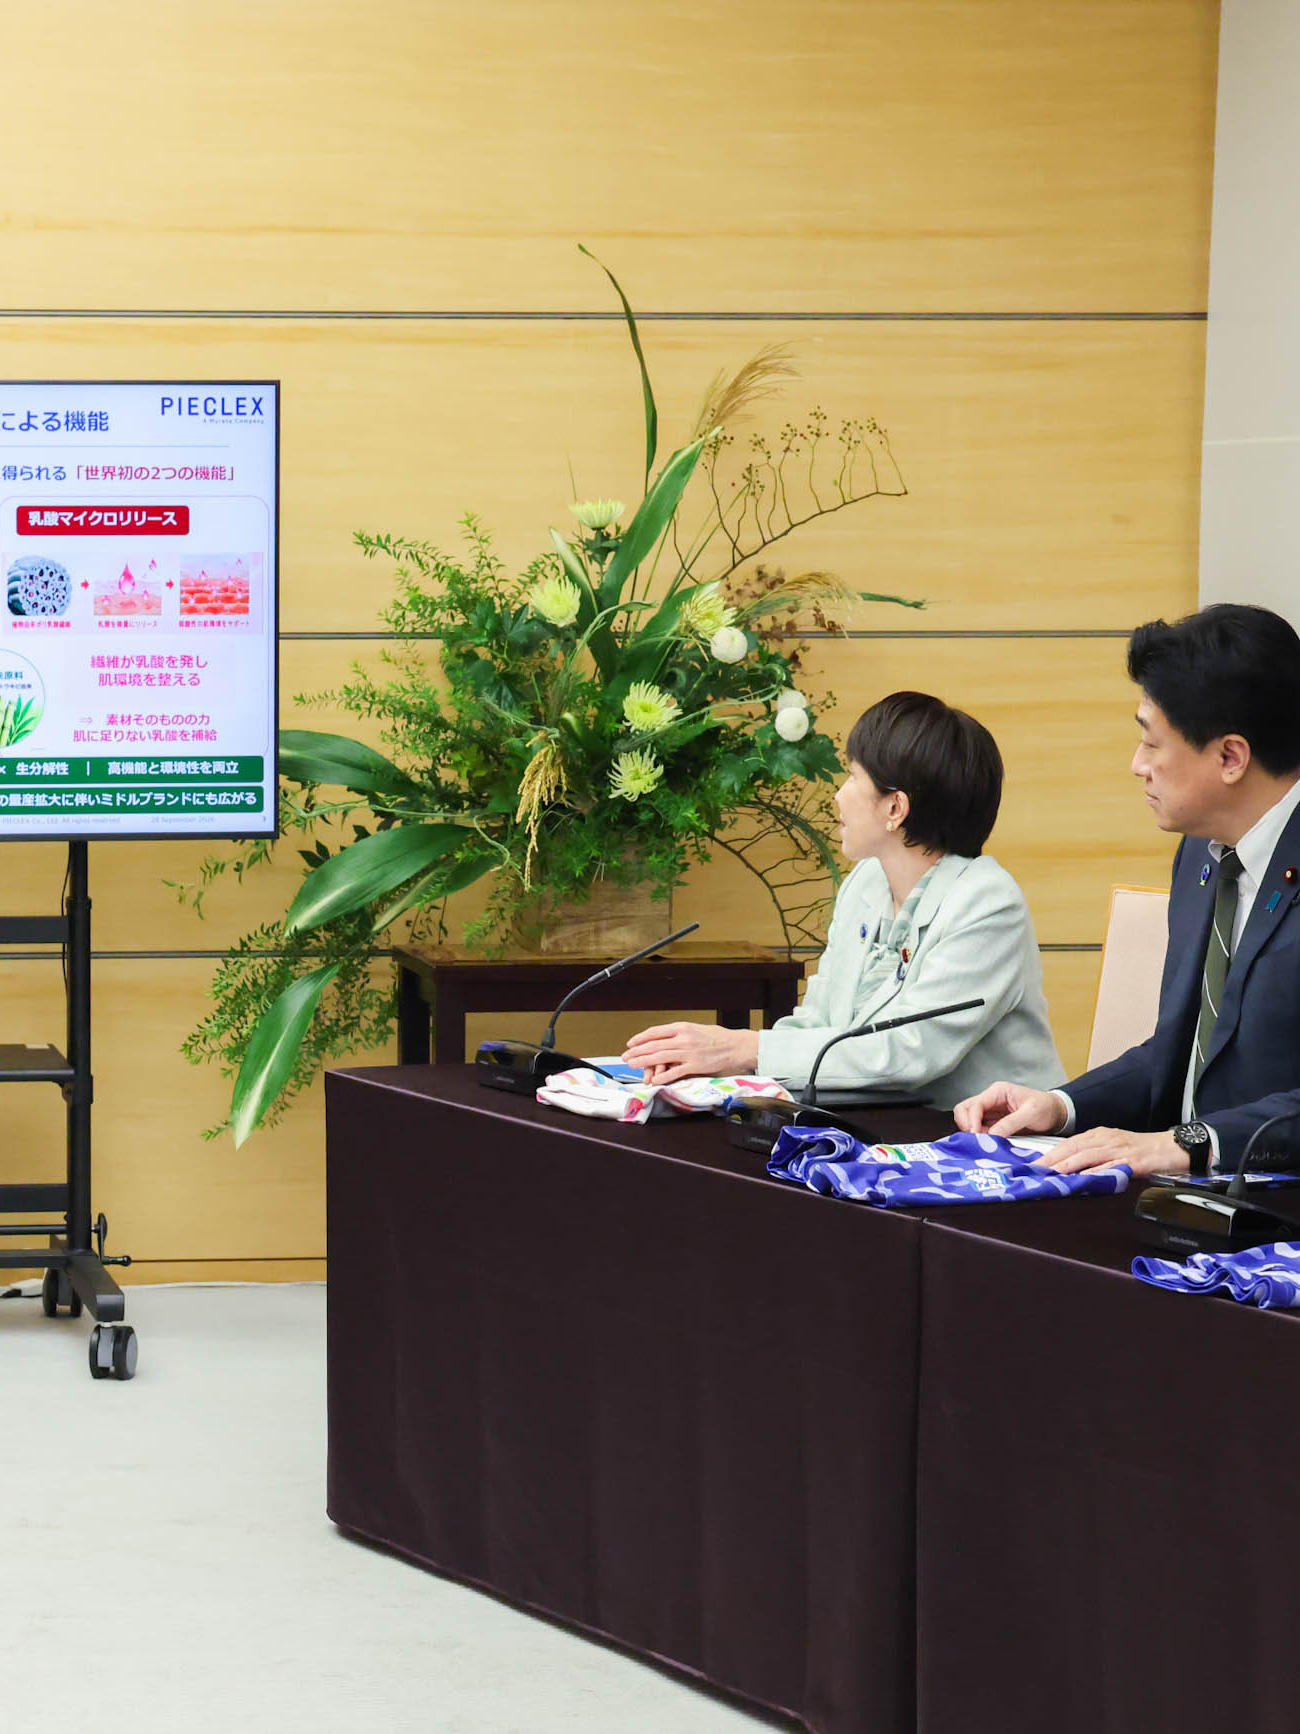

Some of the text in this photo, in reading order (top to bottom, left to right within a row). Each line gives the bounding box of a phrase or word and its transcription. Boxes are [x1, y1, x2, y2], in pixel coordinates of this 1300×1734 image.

[160, 396, 264, 417] PIECLEX
[27, 510, 178, 527] 乳酸マイクロリリース
[90, 654, 209, 670] 繊維が乳酸を発し
[98, 672, 201, 687] 肌環境を整える
[105, 713, 211, 727] 素材そのものの力
[72, 728, 218, 743] 肌に足りない乳酸を補給
[15, 761, 70, 776] 生分解性
[107, 760, 240, 776] 高機能と環境性を両立
